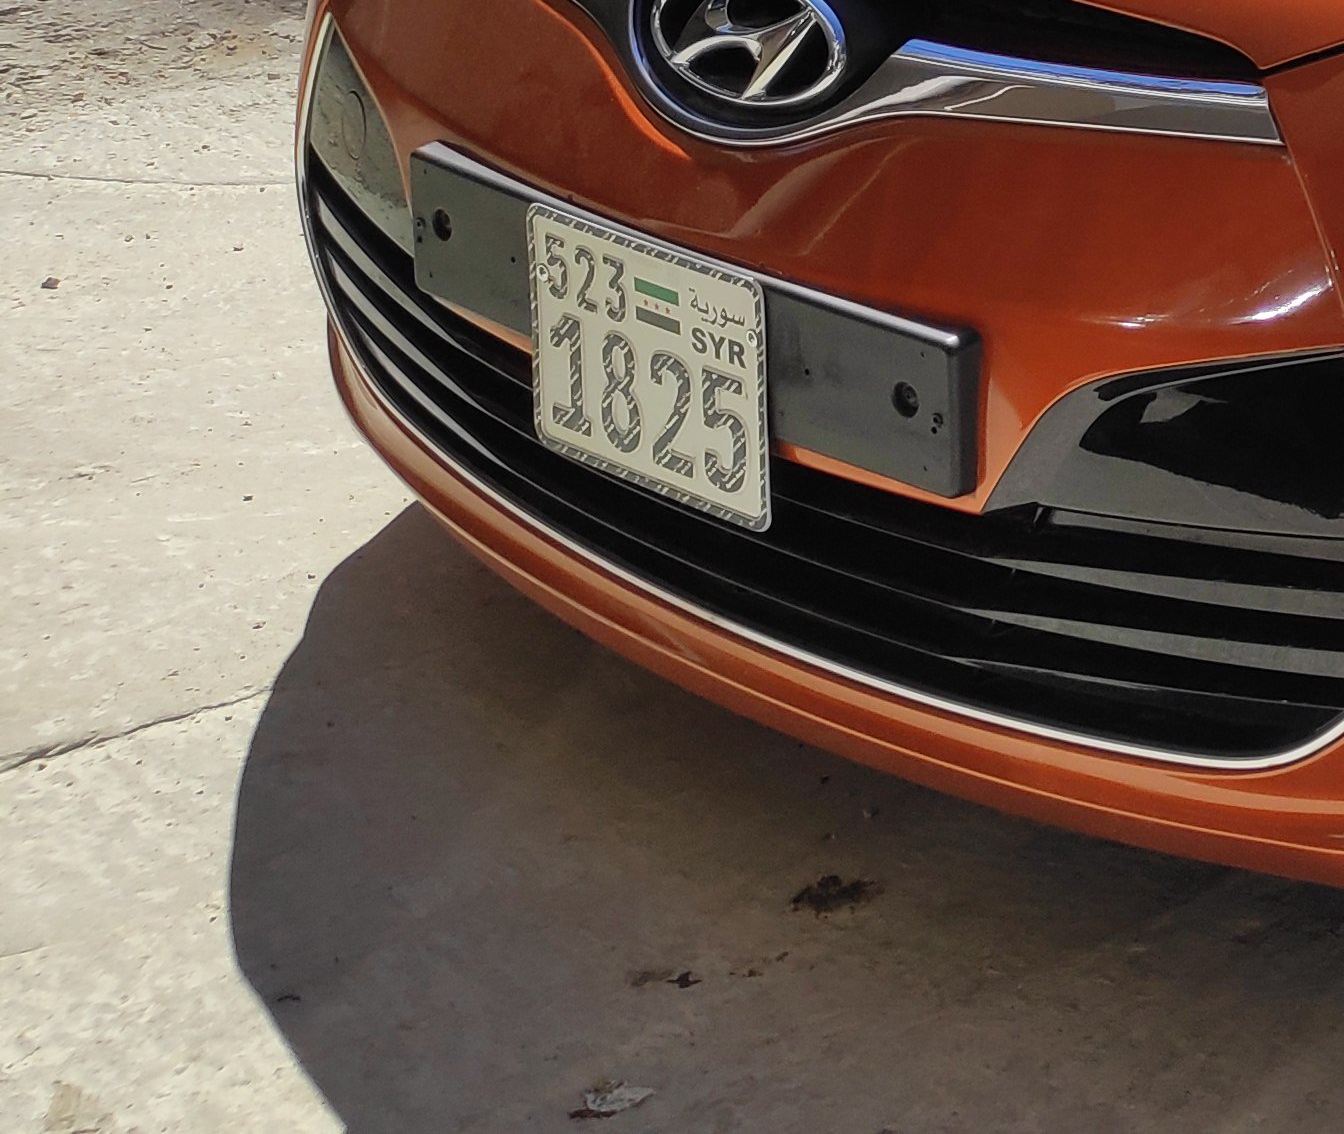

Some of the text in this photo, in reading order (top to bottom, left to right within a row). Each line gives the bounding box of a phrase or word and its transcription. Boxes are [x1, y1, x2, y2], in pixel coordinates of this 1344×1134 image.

[543, 233, 627, 323] 523
[687, 286, 746, 328] سورية
[690, 326, 748, 370] SYR
[548, 312, 751, 494] 1825
